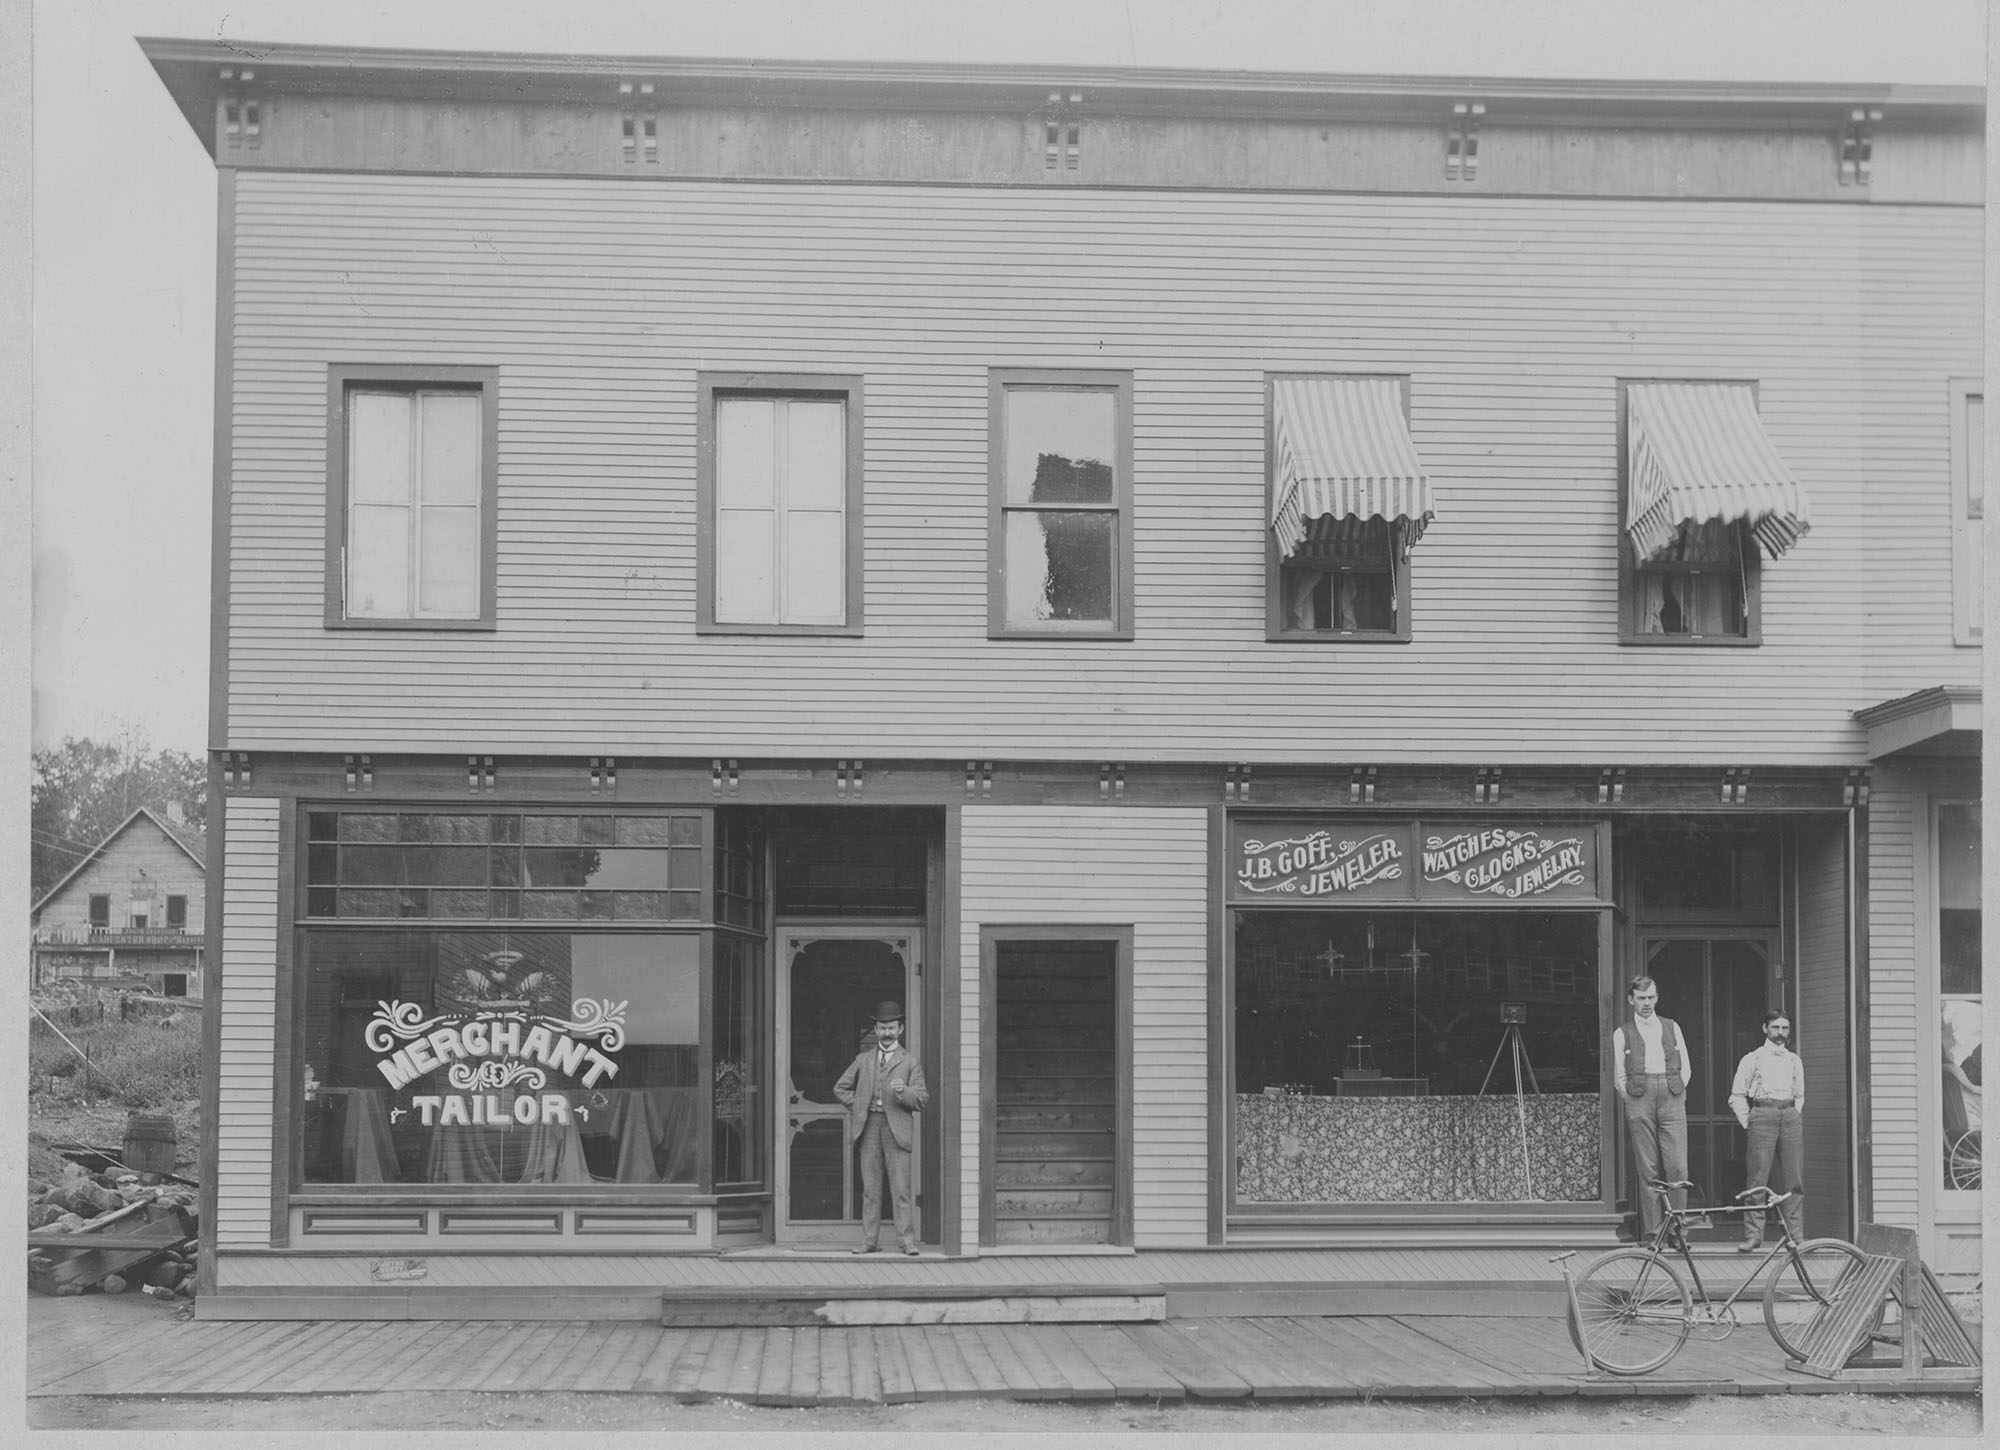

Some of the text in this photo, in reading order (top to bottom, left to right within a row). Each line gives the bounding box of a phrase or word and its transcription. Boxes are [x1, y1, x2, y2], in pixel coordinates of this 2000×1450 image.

[1278, 837, 1336, 874] GOFF,
[1300, 838, 1402, 895] JEWELER.
[1423, 828, 1512, 873] WATCHES,
[1464, 840, 1542, 888] CLOCKS,
[1506, 845, 1585, 897] JEWELRY.
[376, 1021, 619, 1090] MERCHANT
[412, 1094, 570, 1126] TAILOR
